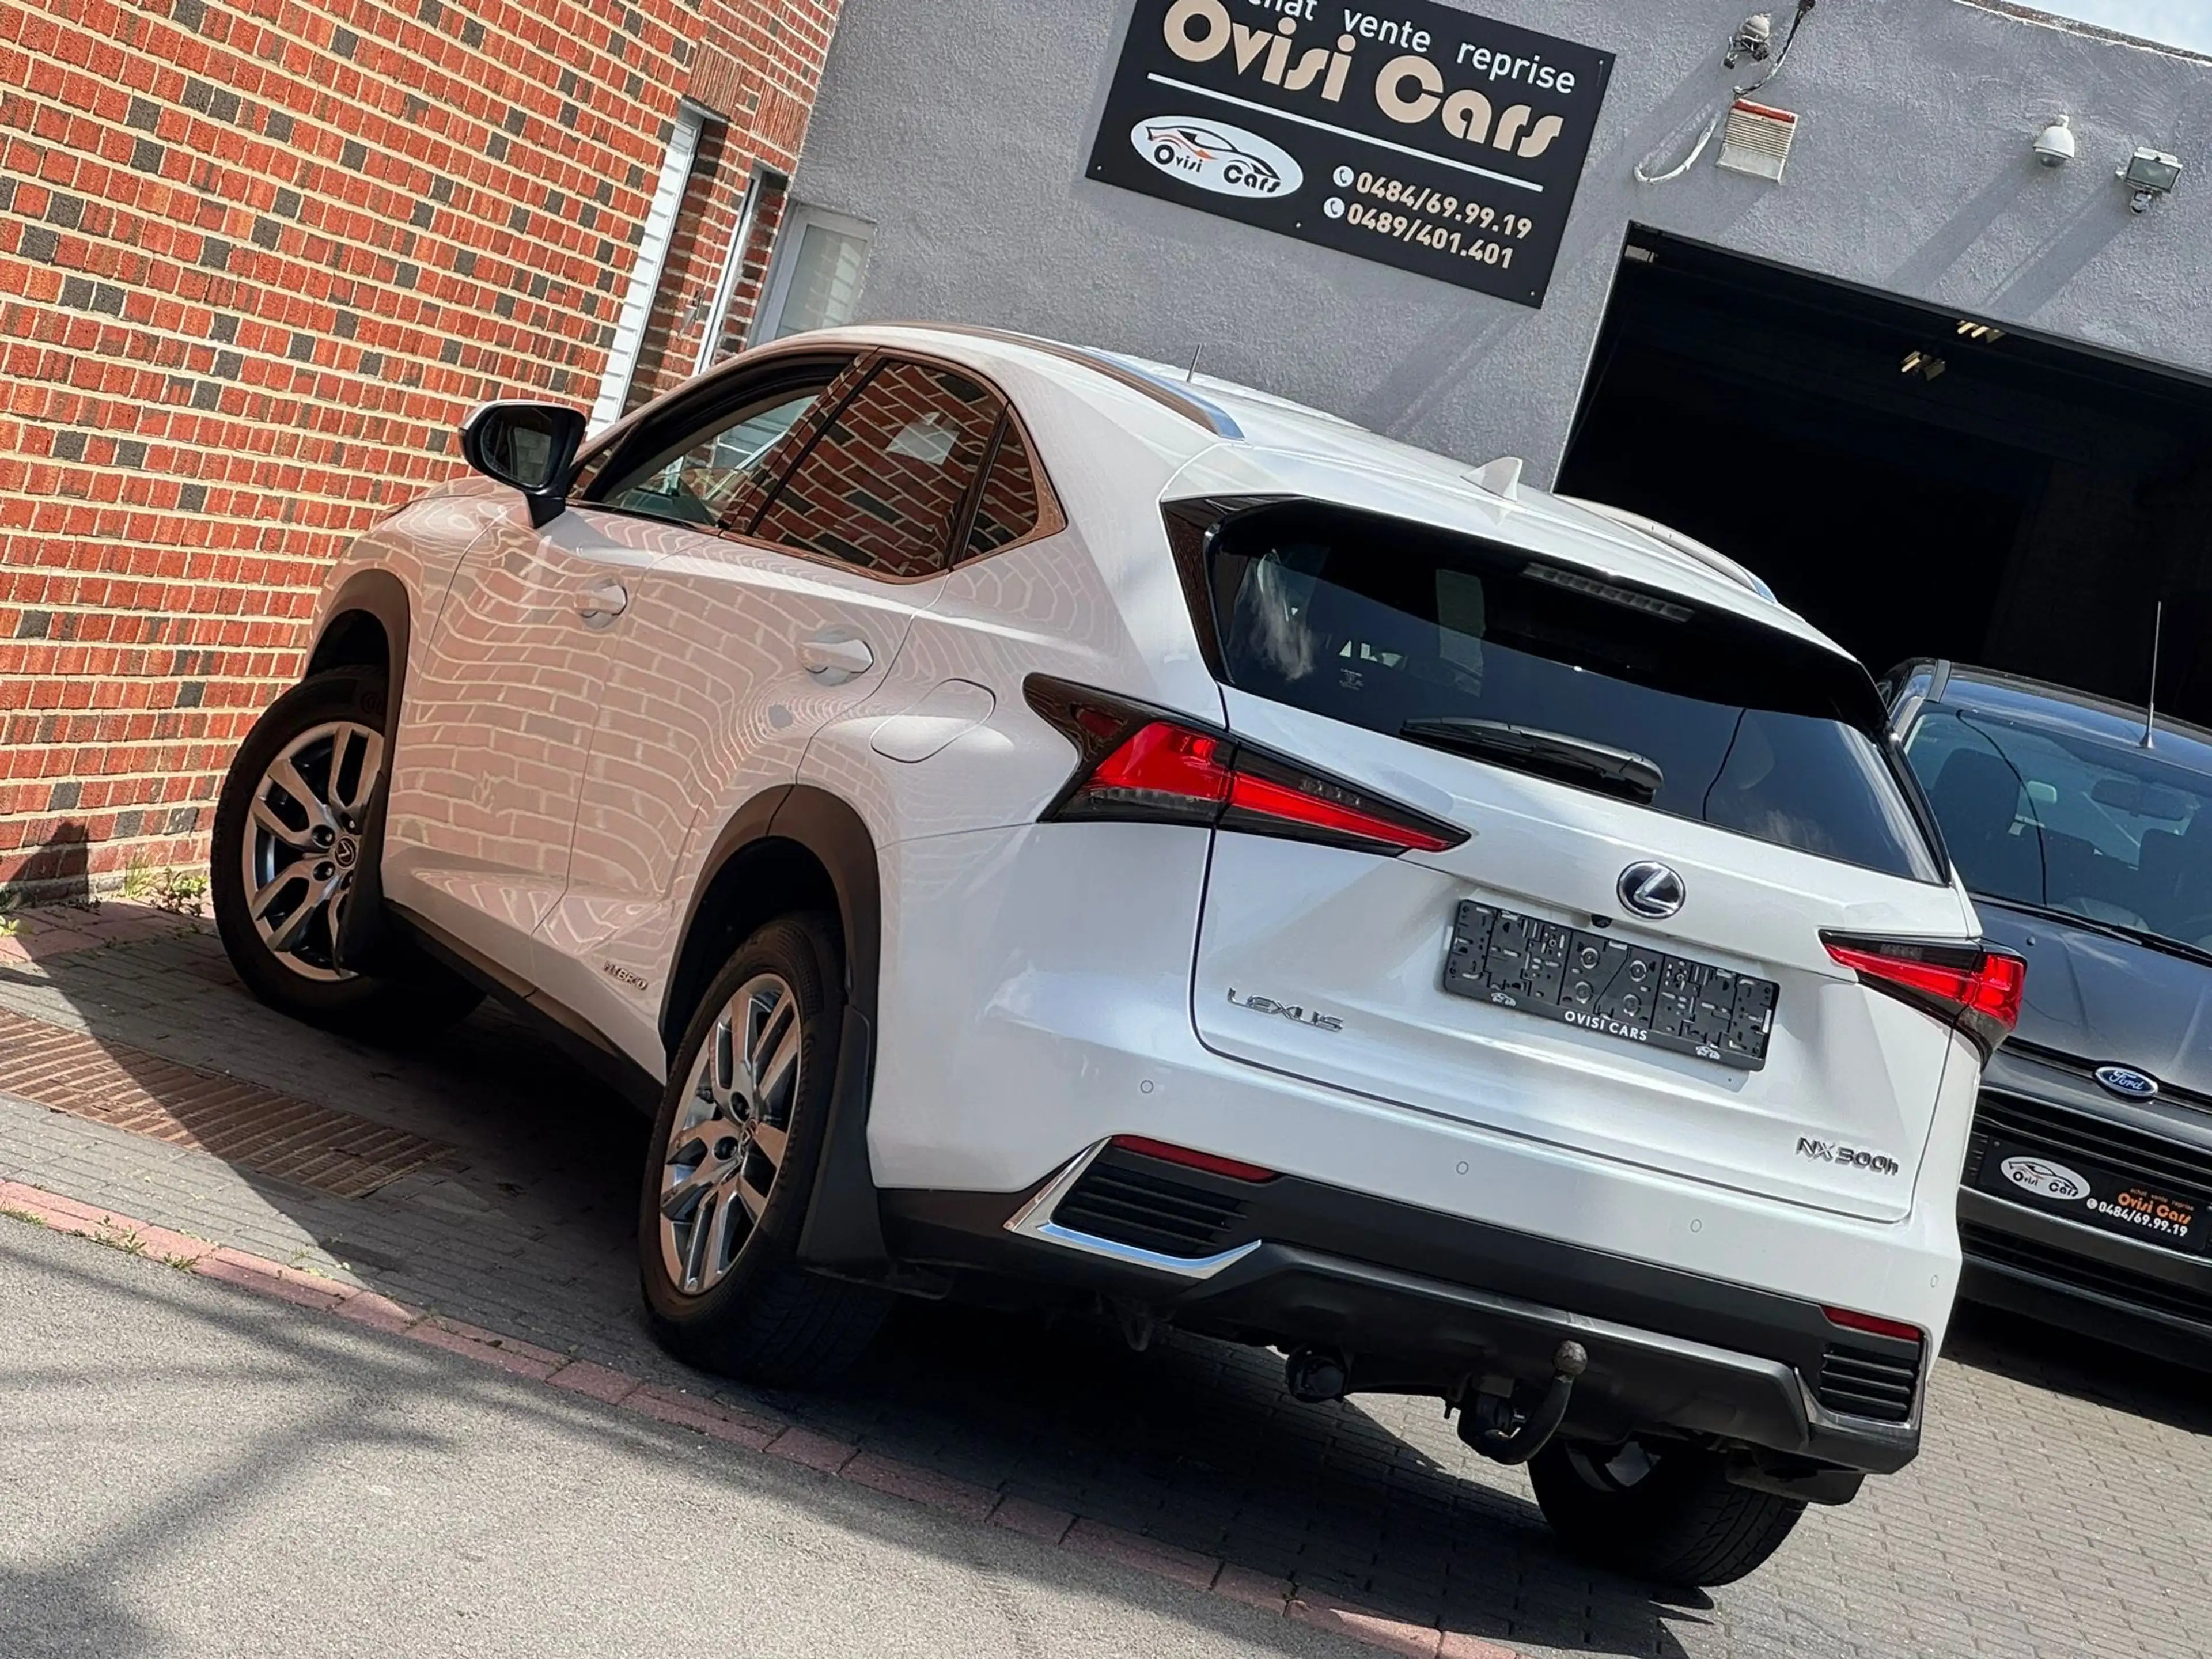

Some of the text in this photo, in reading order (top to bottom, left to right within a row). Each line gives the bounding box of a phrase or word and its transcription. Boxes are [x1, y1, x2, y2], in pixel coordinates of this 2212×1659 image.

[1344, 9, 1431, 53] vente
[1456, 43, 1575, 94] reprise
[1164, 0, 1564, 158] Ovisi Cars
[1153, 144, 1281, 193] Ovisi Cars
[1357, 172, 1532, 239] 0484/69.99.19
[1347, 203, 1513, 268] 0489/401.401
[1228, 987, 1344, 1032] LEXUS
[1565, 1010, 1648, 1041] OVISI CARS
[2109, 1070, 2145, 1090] Ford
[2098, 1201, 2188, 1237] 0484/69.99.19
[2118, 1192, 2154, 1213] Ovisi
